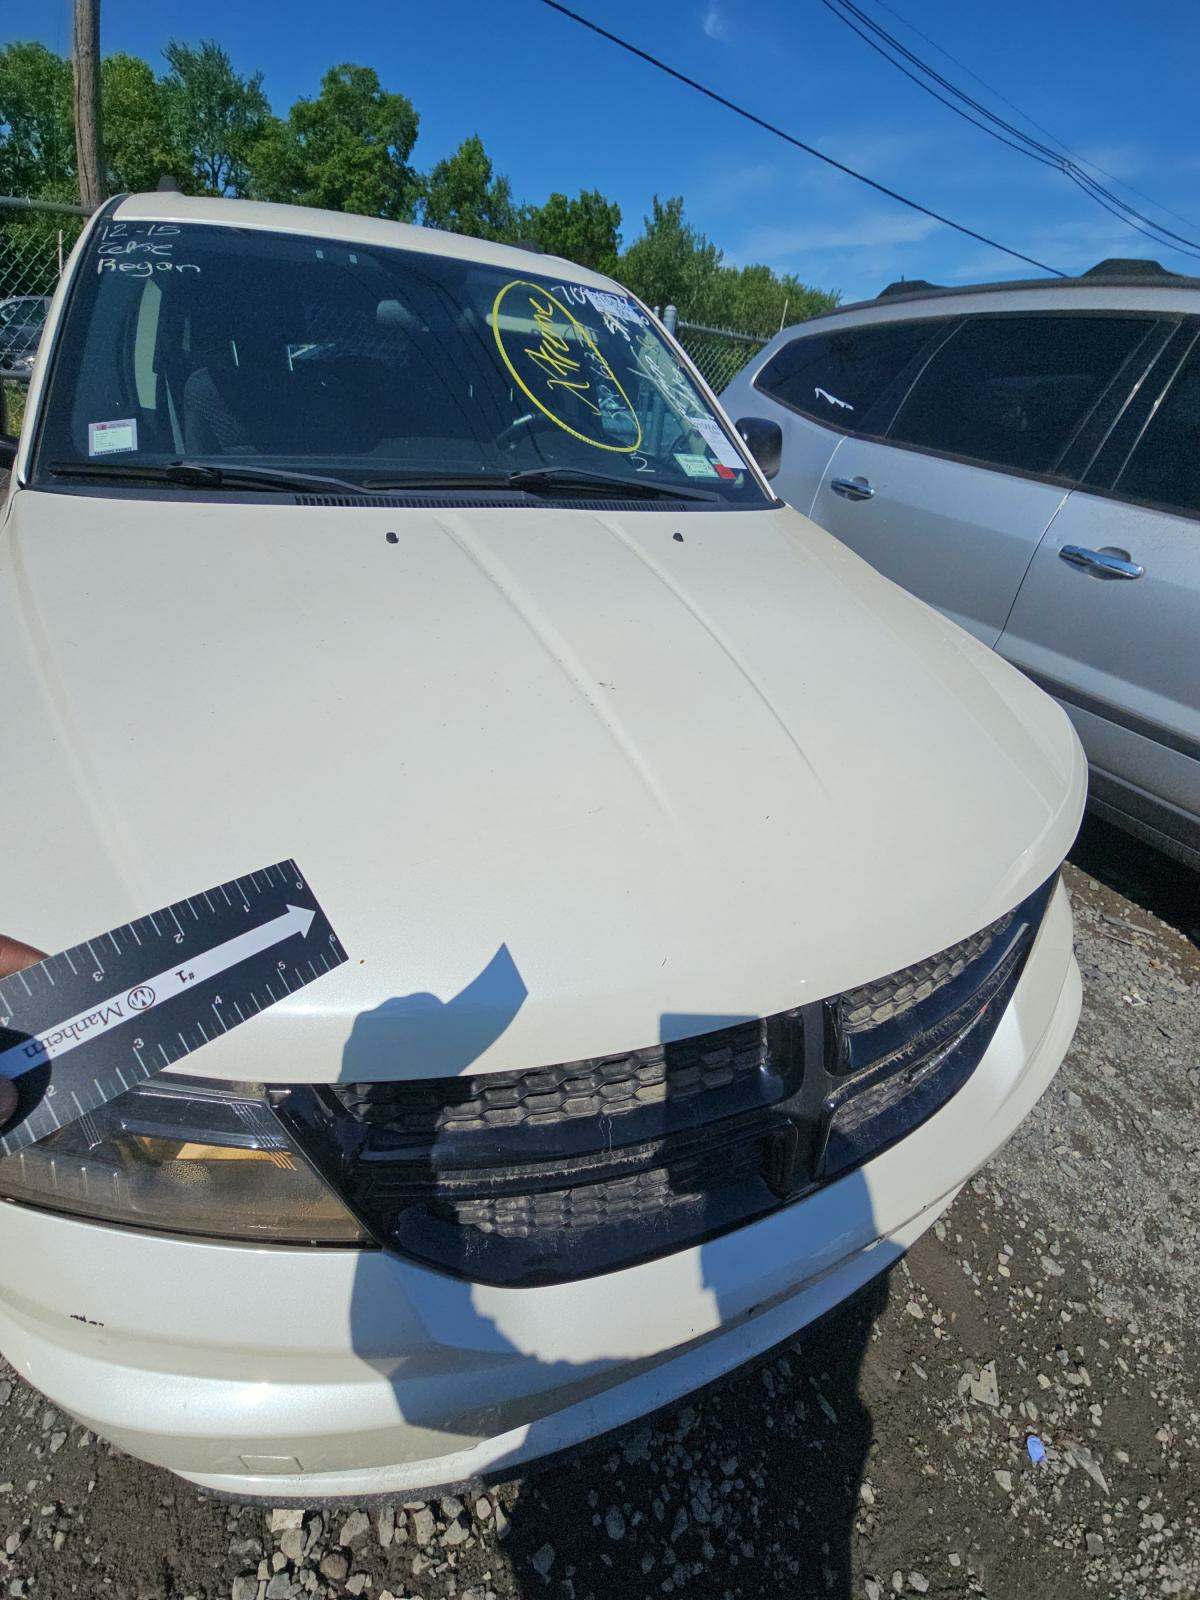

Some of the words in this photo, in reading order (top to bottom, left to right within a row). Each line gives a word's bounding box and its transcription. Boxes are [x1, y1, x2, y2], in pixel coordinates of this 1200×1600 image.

[174, 933, 184, 944] 2
[92, 971, 104, 982] 3
[23, 1002, 124, 1058] Manheim
[134, 1038, 145, 1049] 3
[214, 995, 222, 1005] 4
